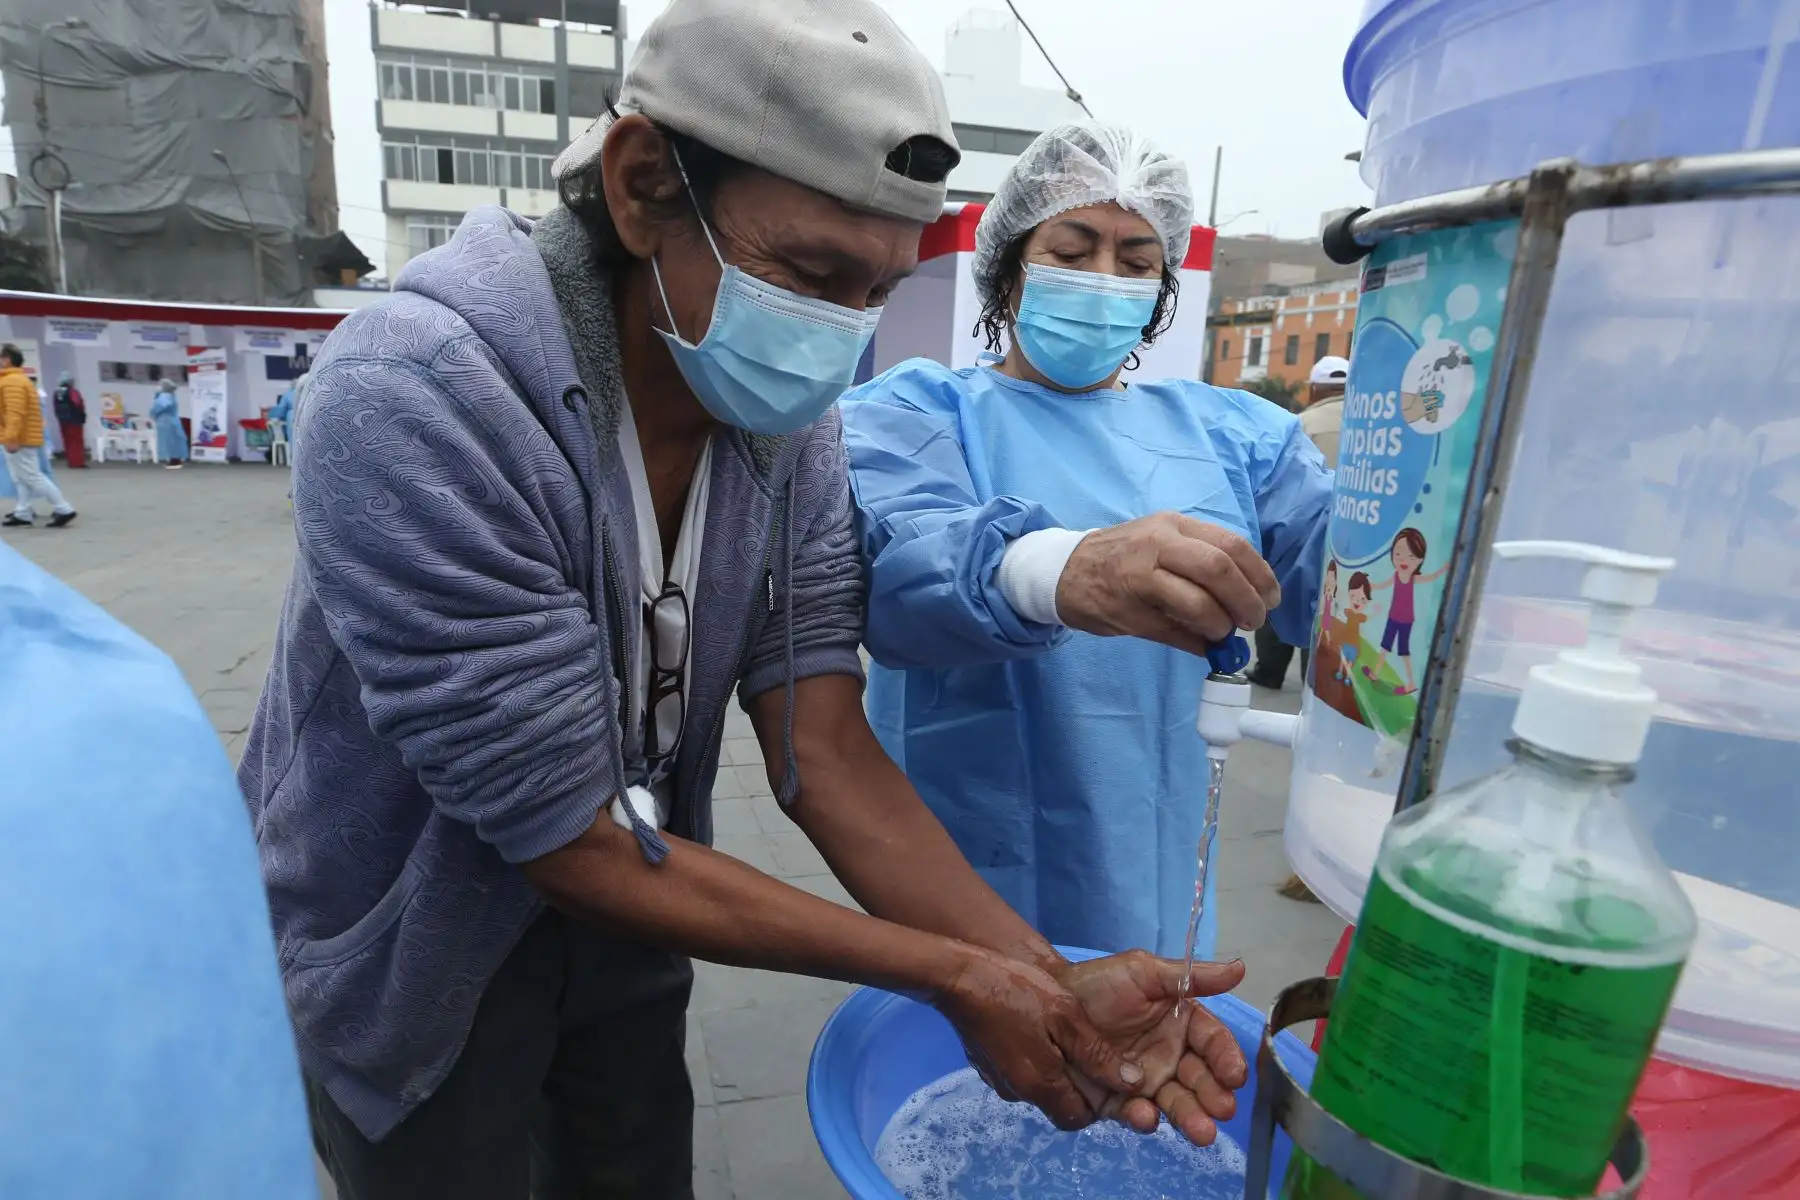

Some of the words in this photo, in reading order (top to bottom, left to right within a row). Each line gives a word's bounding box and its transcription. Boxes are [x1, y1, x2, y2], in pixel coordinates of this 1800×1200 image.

[1342, 420, 1402, 464] mpias
[1338, 458, 1399, 496] amilias
[1334, 494, 1381, 526] sanas
